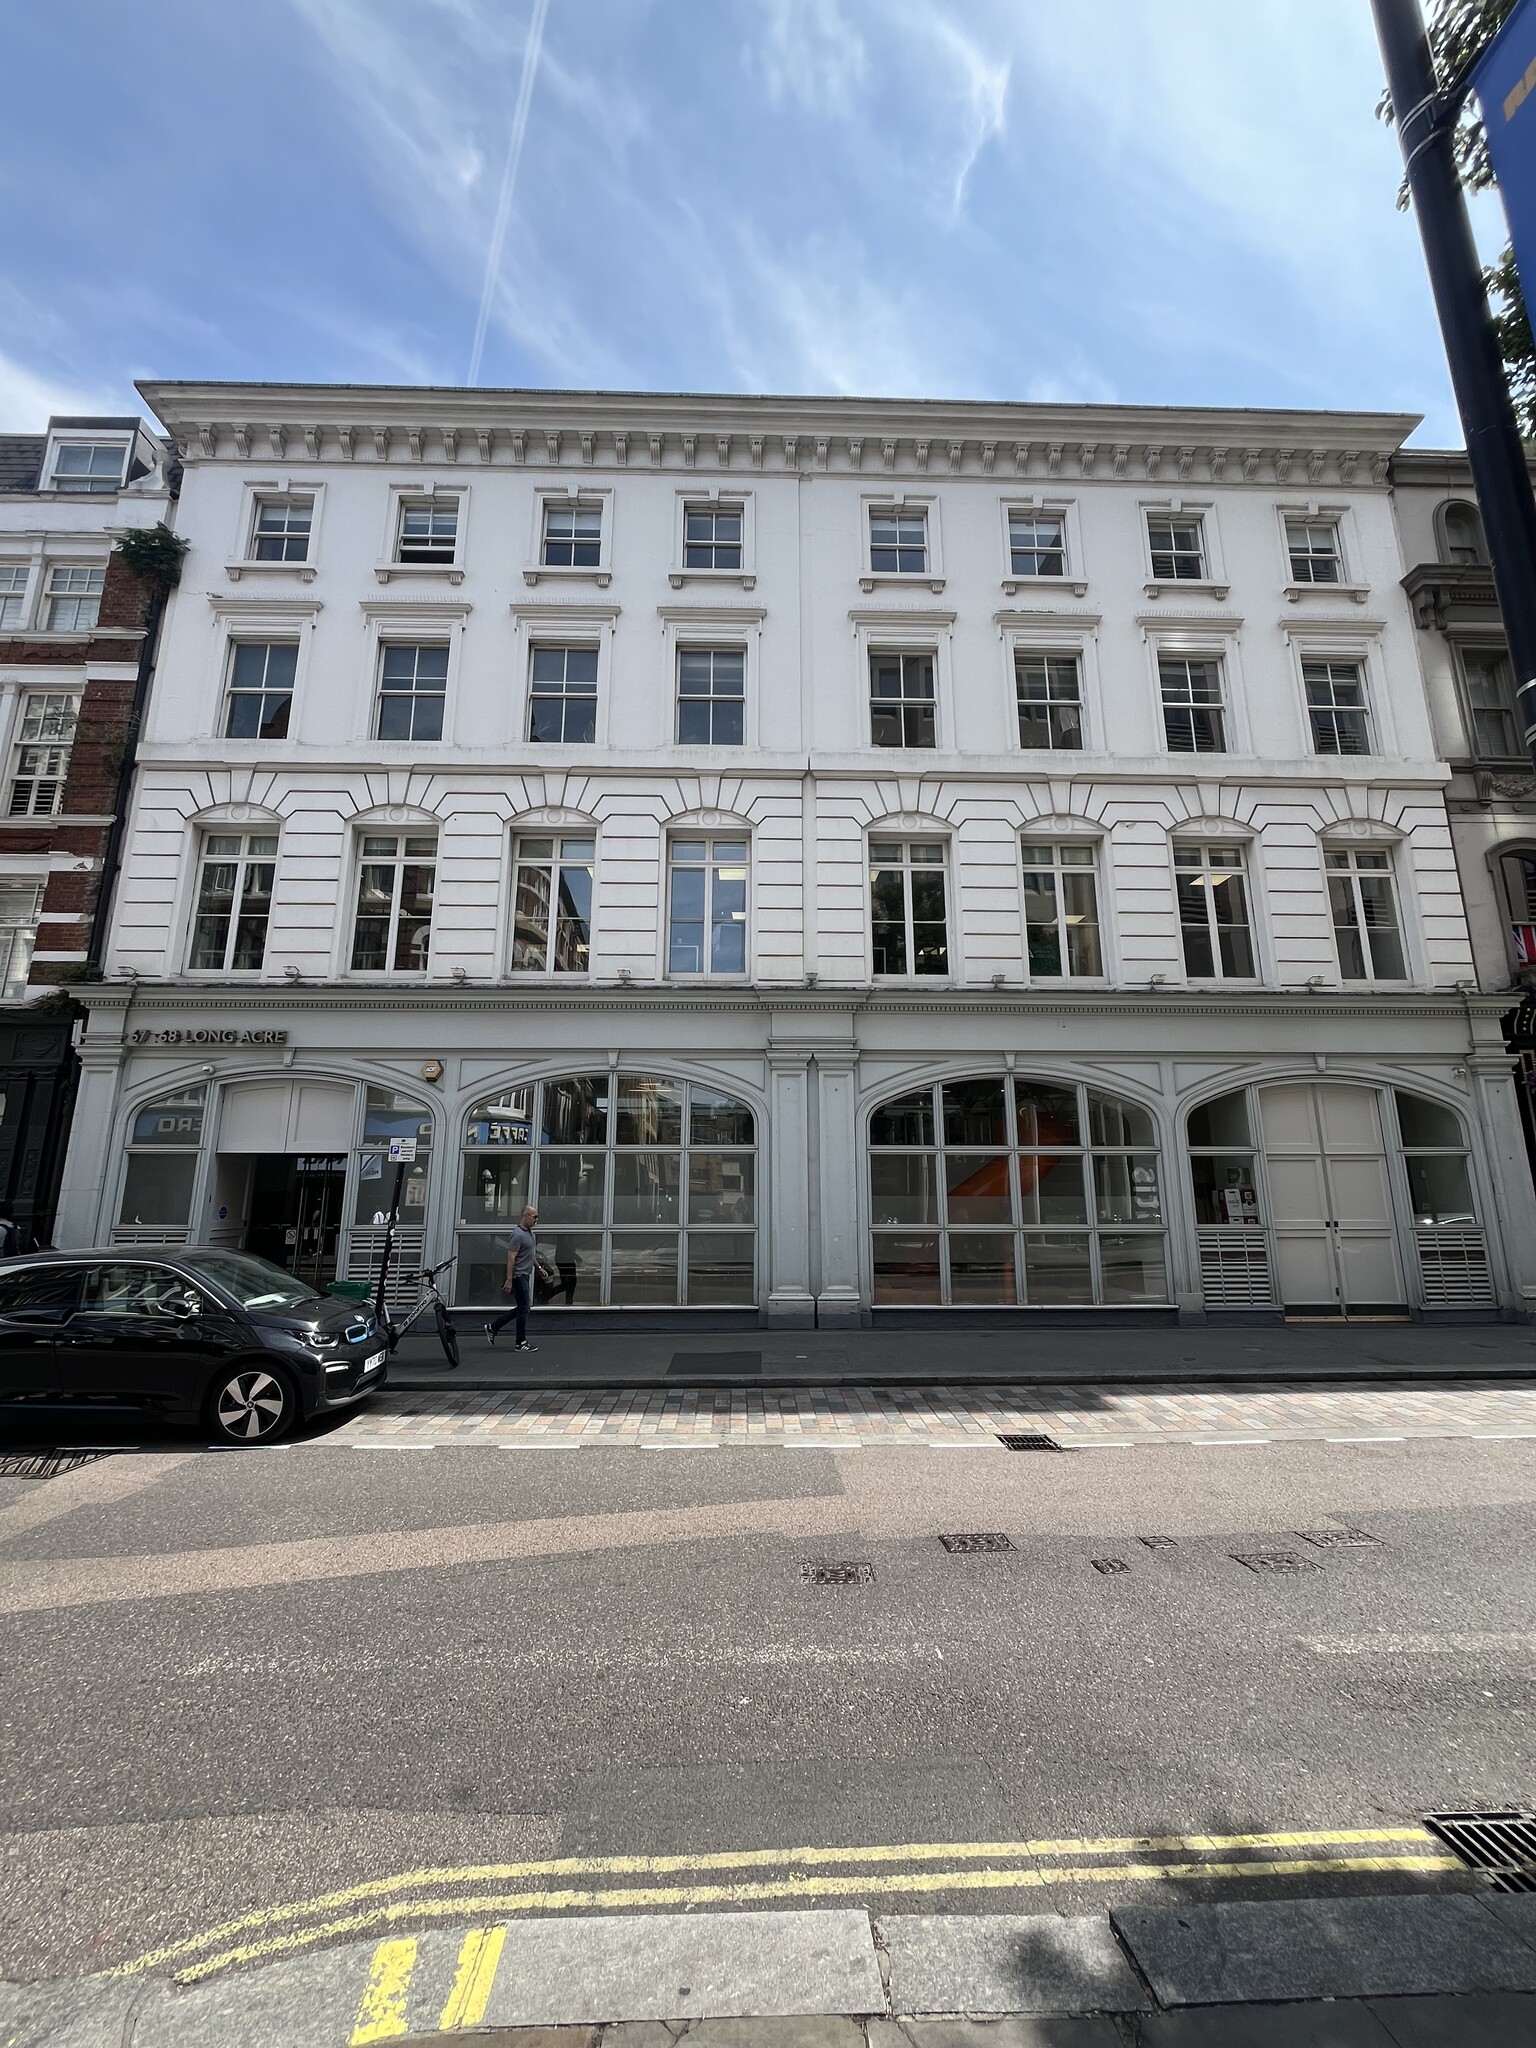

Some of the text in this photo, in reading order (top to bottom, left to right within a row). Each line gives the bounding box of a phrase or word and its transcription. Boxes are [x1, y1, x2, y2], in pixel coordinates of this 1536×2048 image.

[184, 1029, 235, 1043] LONG
[240, 1030, 286, 1043] ACRE
[391, 1146, 399, 1154] P
